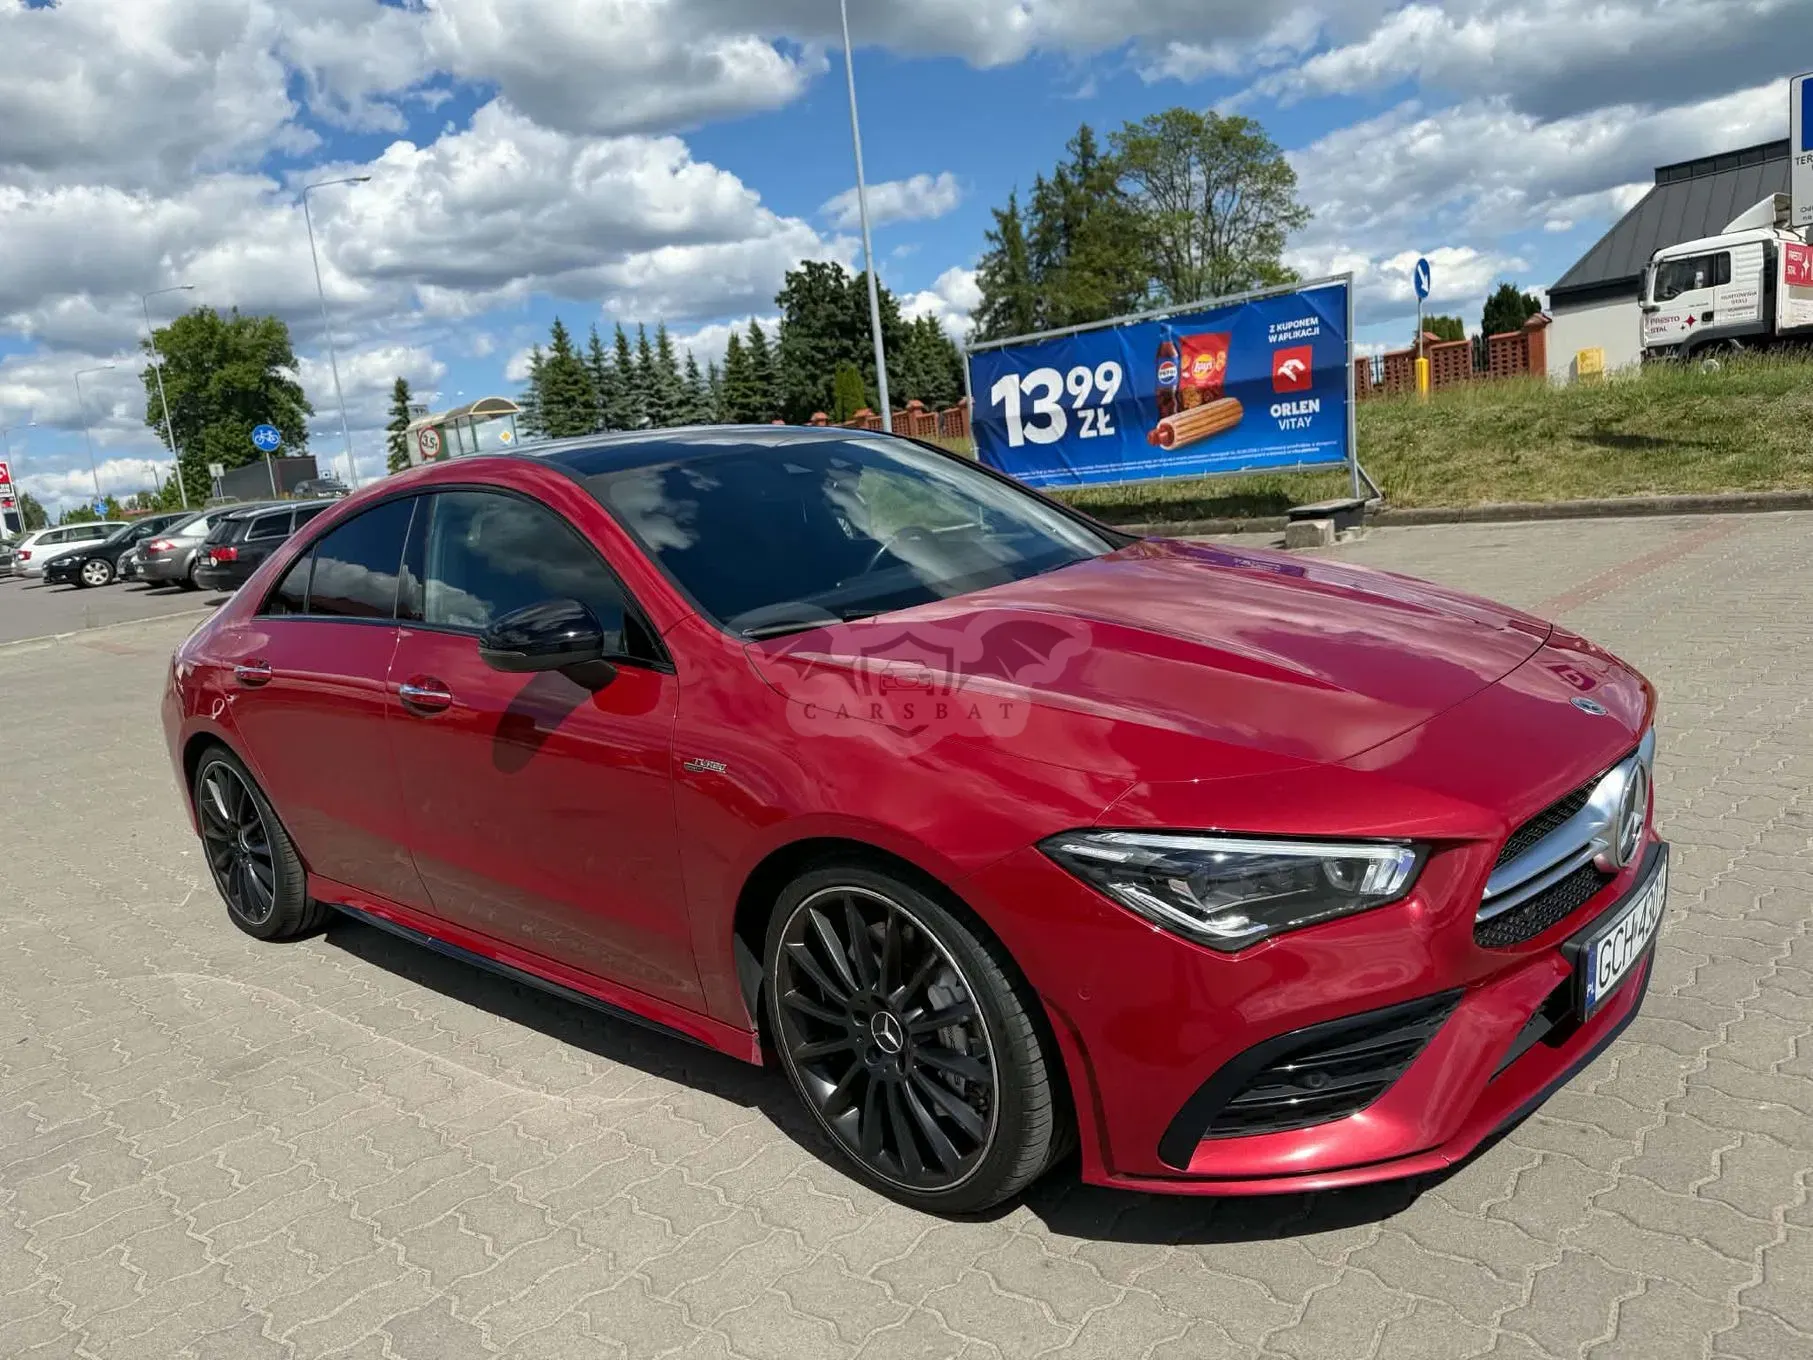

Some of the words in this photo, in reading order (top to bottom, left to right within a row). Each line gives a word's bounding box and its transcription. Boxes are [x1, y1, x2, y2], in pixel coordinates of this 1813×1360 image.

[1269, 324, 1276, 334] Z
[1277, 316, 1319, 332] KUPONEM
[1650, 315, 1680, 325] PRESTO
[1268, 334, 1277, 343] W
[1278, 326, 1320, 342] APLIKACJI
[1650, 326, 1667, 334] STAL
[1270, 398, 1320, 418] ORLEN
[1077, 407, 1115, 439] ZŁ
[1278, 415, 1312, 431] VITAY
[1599, 912, 1636, 989] GCH
